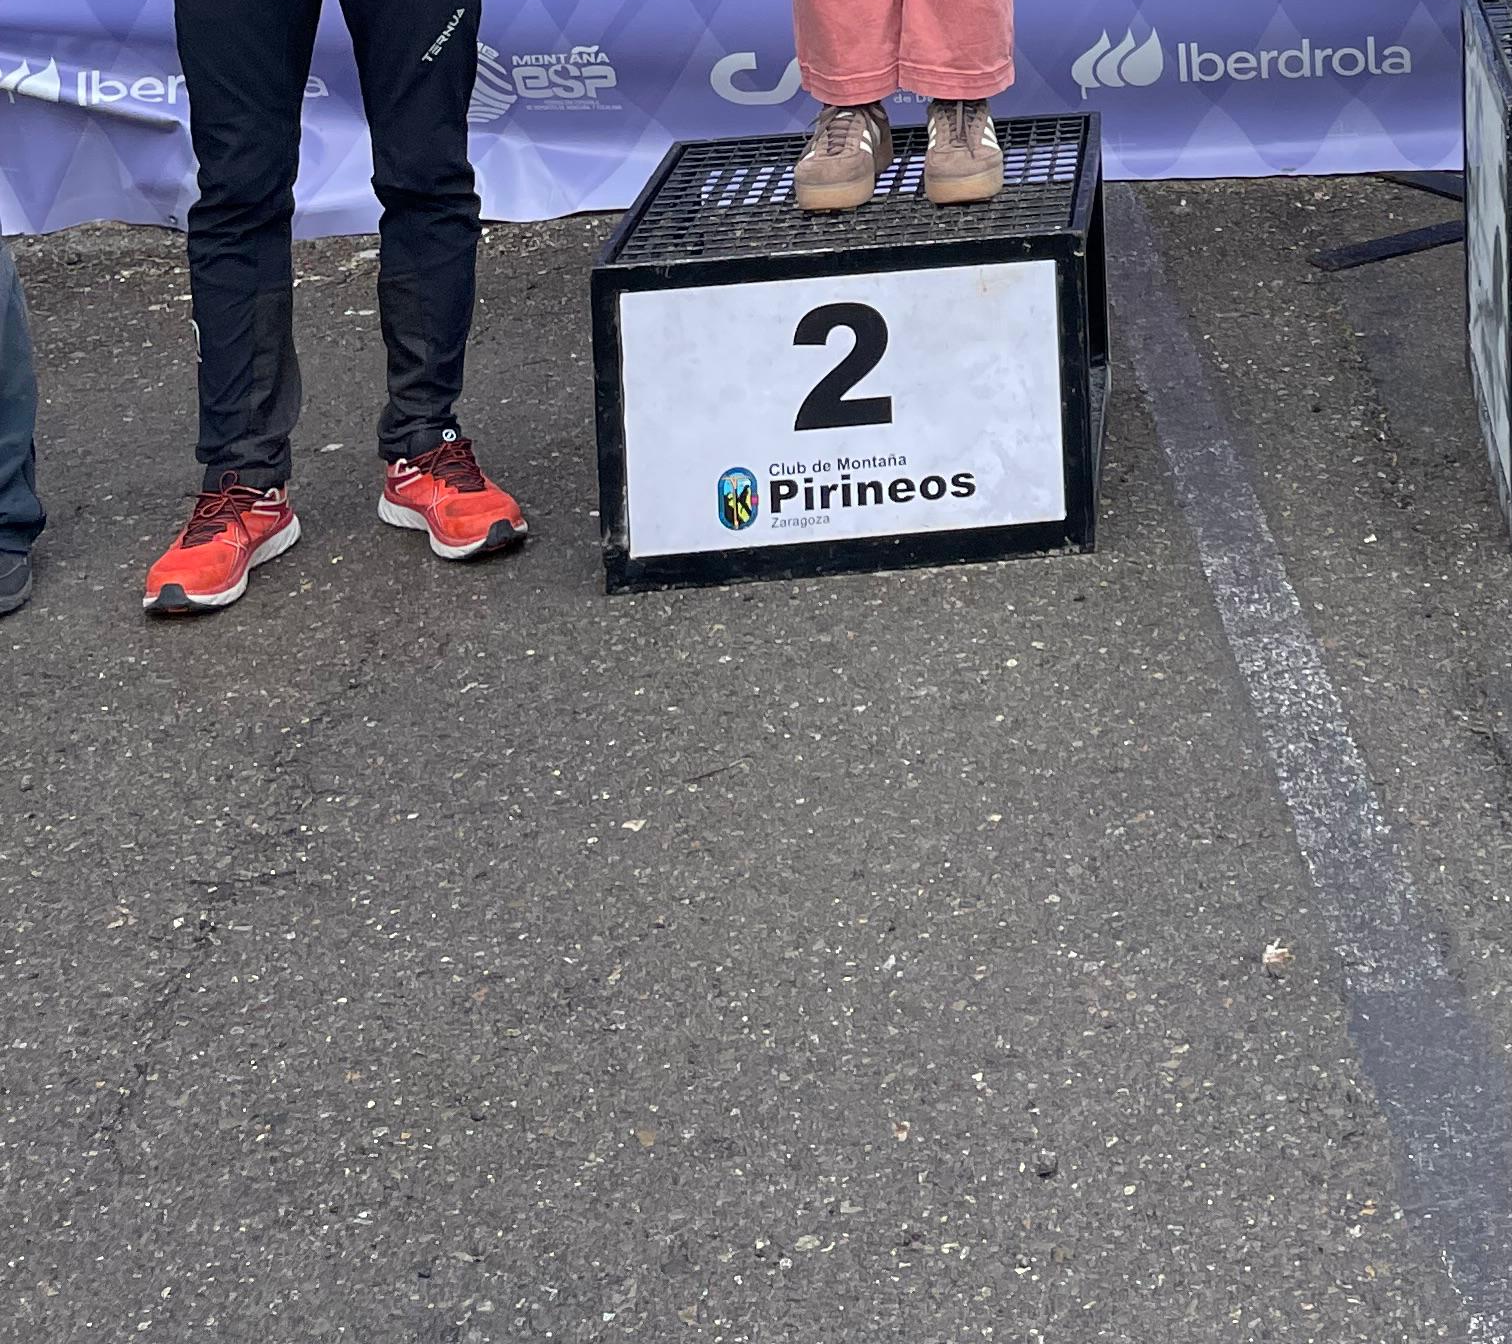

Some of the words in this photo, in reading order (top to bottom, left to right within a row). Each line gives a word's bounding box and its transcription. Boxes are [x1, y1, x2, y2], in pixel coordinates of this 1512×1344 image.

[421, 8, 465, 62] TERNUA
[512, 45, 610, 66] MONTAÑA
[1177, 36, 1412, 82] Iberdrola
[792, 302, 893, 432] 2
[769, 462, 807, 477] Club
[812, 459, 831, 473] de
[837, 453, 907, 471] Montaña
[769, 472, 976, 514] Pirineos
[771, 514, 830, 529] Zaragoza
